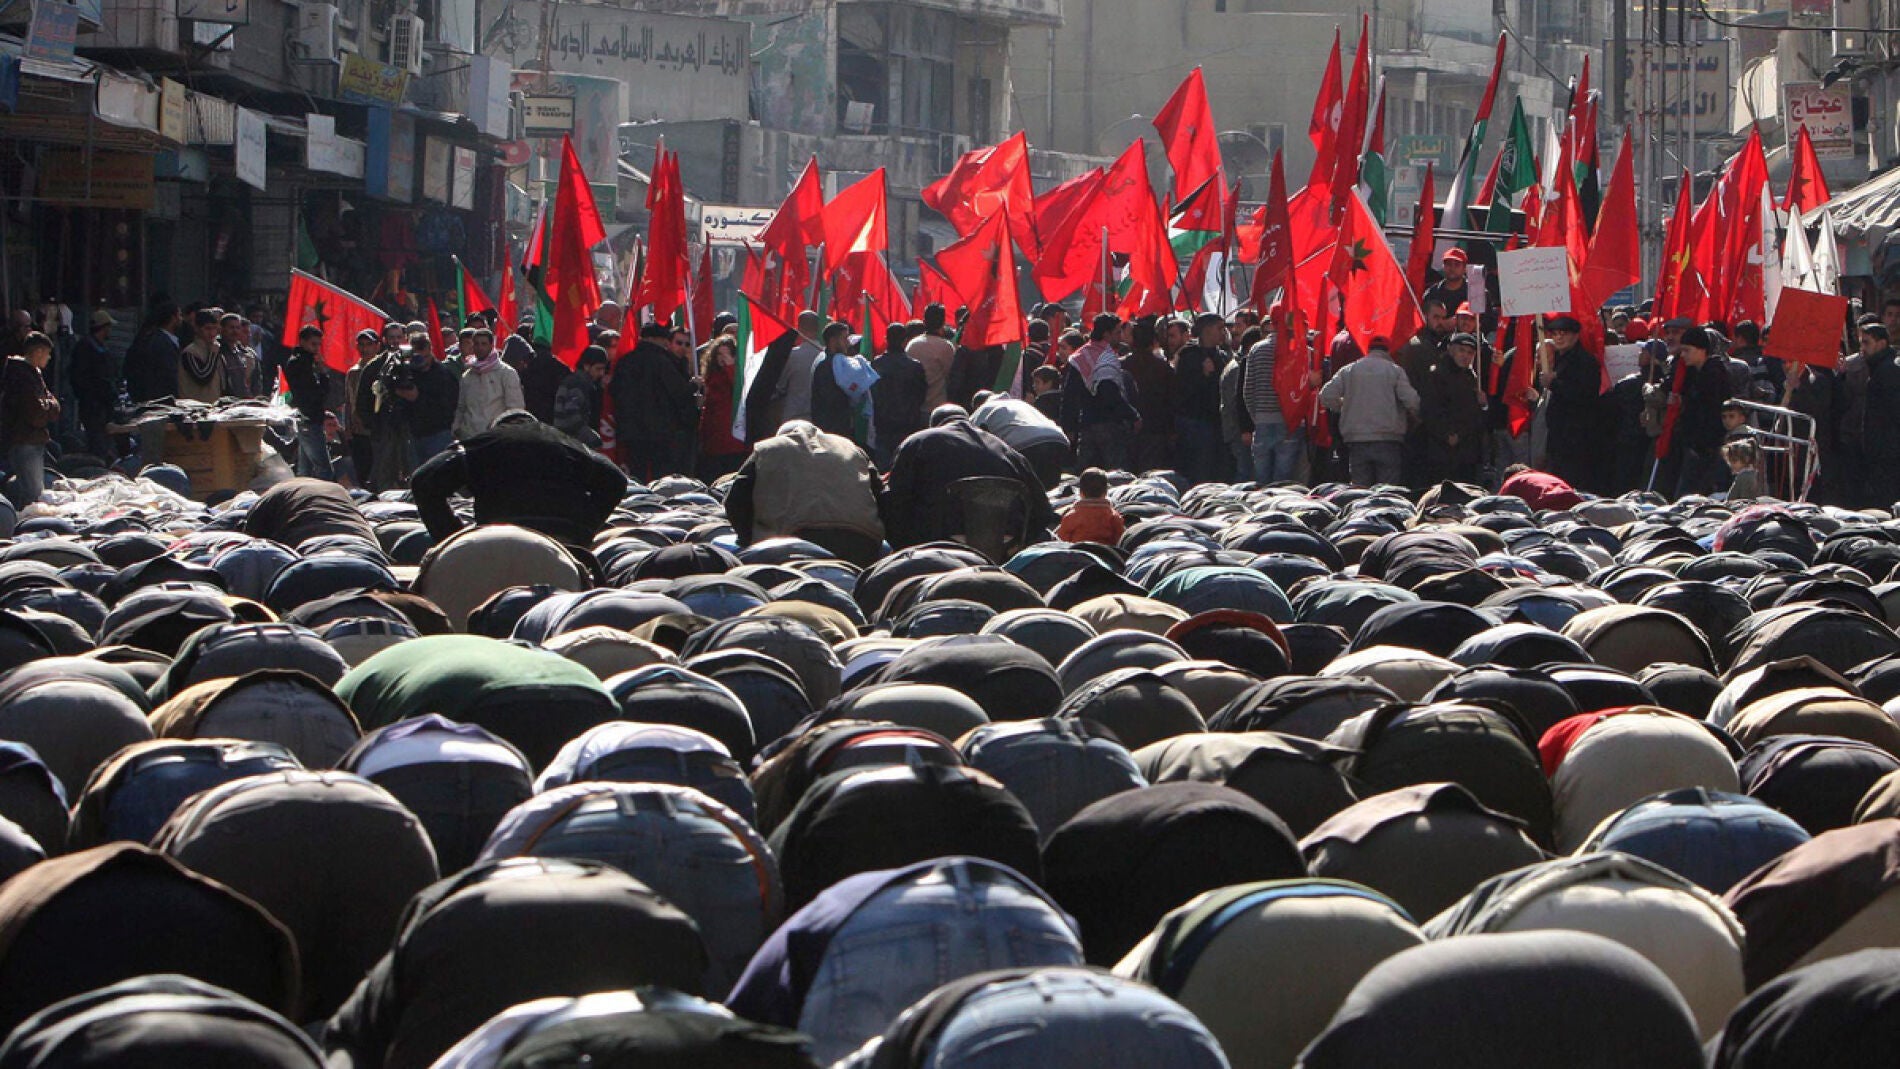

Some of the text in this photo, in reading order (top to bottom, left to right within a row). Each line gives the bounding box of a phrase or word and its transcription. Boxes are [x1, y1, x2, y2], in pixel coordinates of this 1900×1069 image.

[547, 18, 744, 76] البنك العربي الاسلامي الدول
[1790, 94, 1843, 122] عجاج
